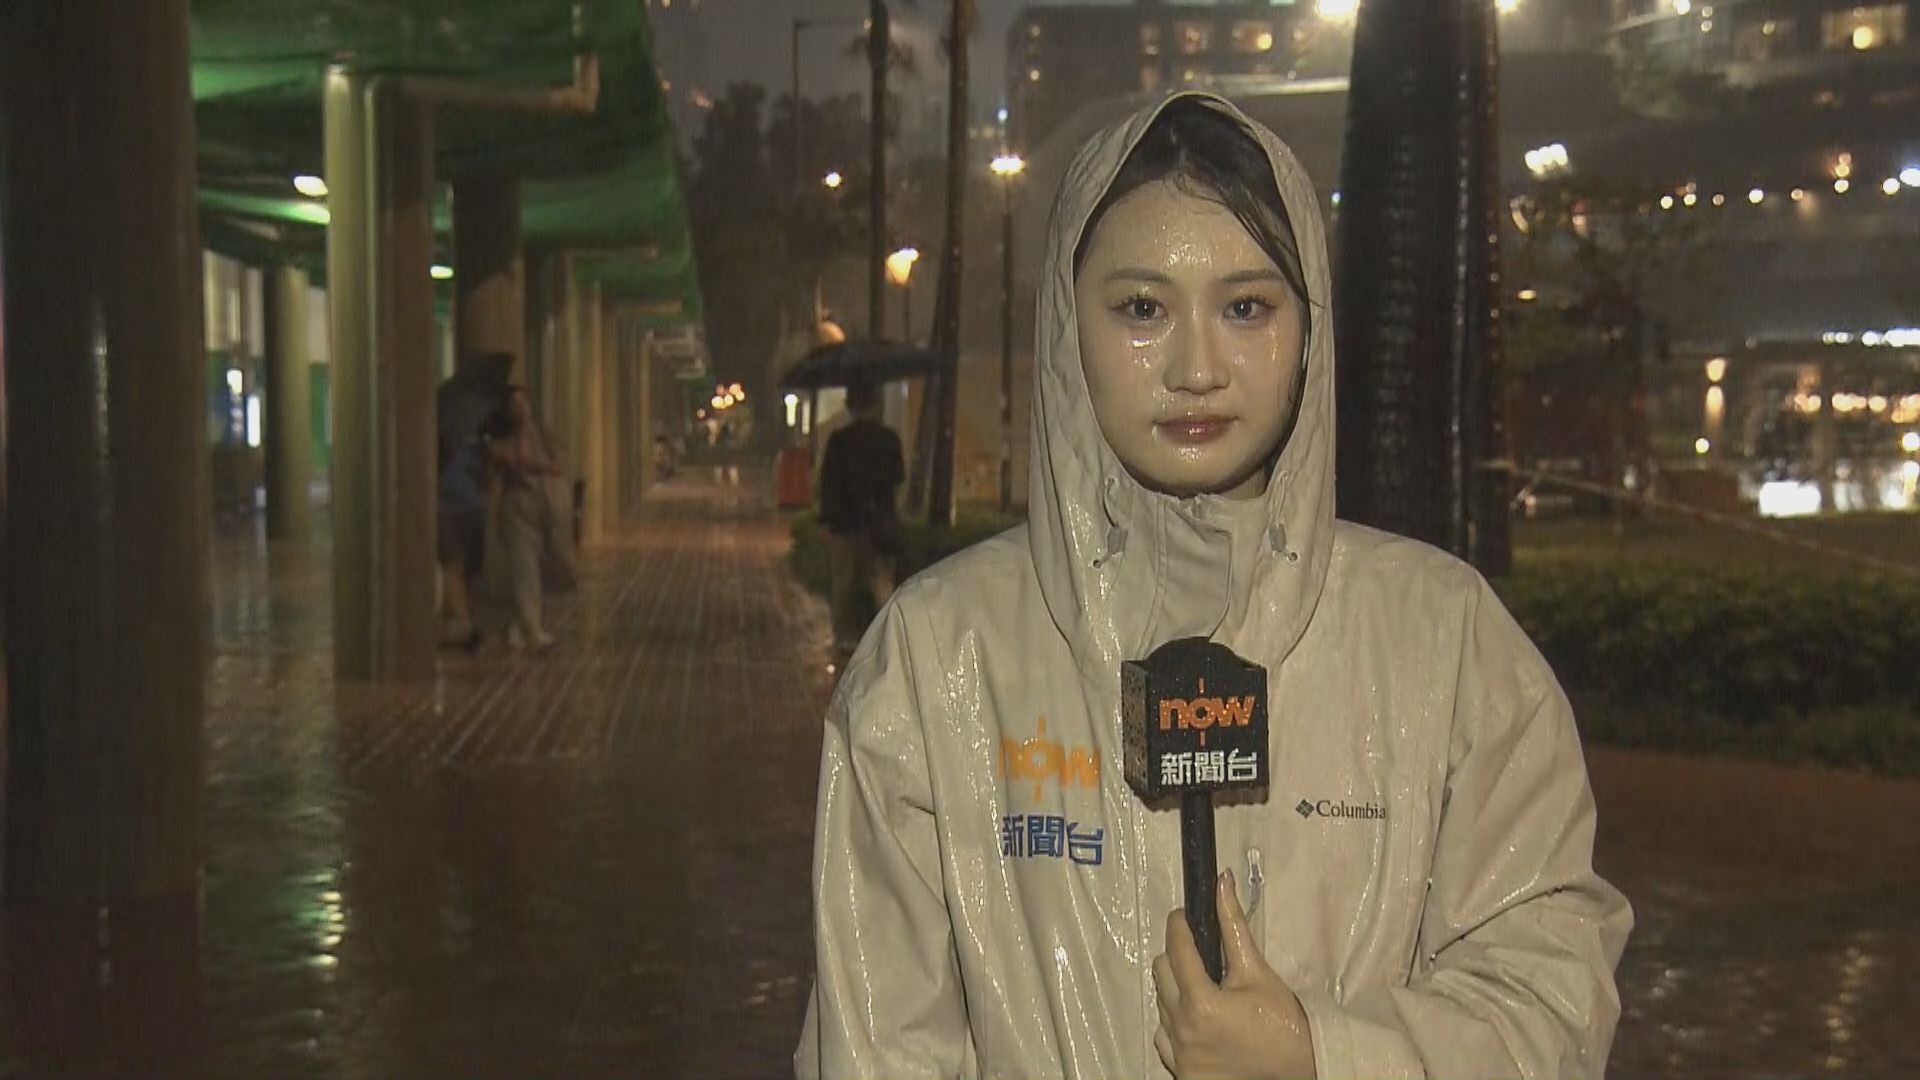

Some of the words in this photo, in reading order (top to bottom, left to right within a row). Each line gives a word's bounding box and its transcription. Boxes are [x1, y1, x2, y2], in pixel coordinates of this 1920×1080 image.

[1158, 695, 1256, 730] now
[998, 737, 1102, 788] now
[1160, 748, 1258, 785] 新聞台
[1316, 799, 1386, 819] Columbia
[1001, 814, 1104, 866] 新聞台
